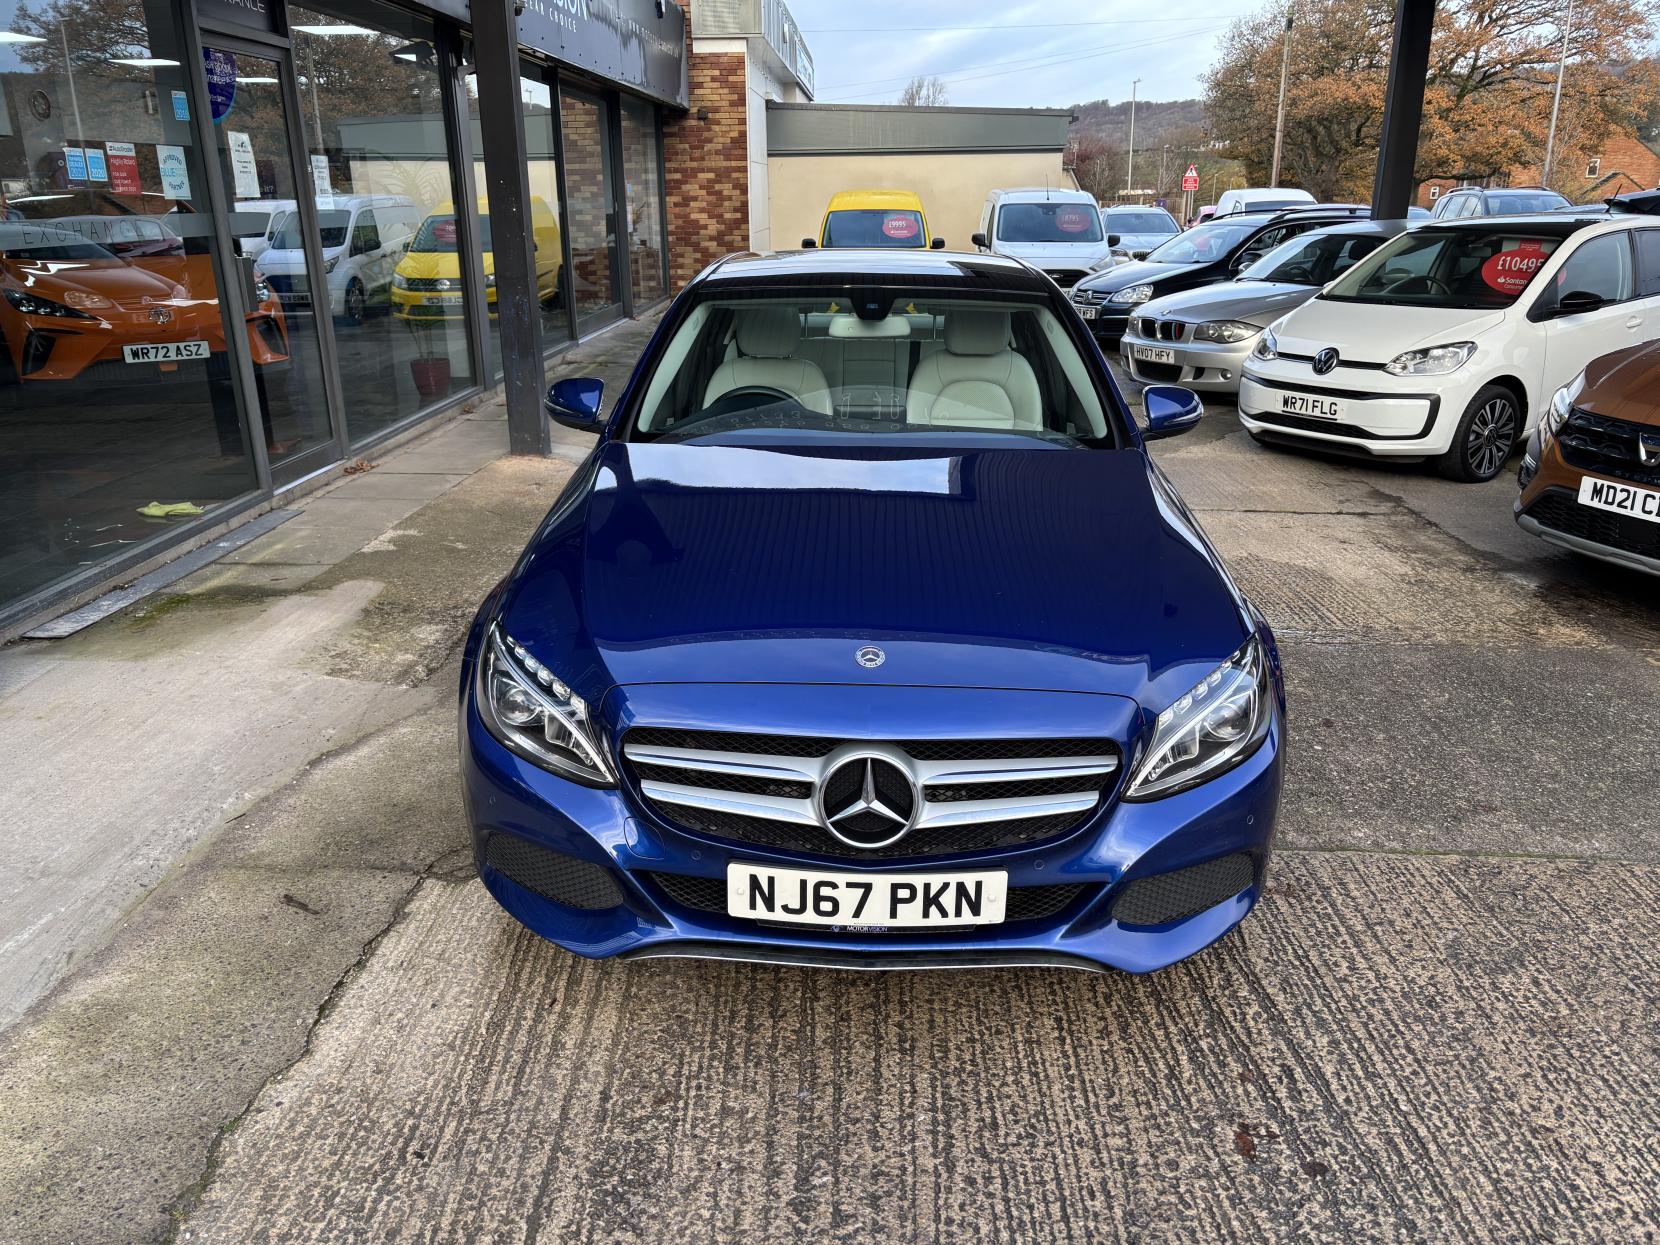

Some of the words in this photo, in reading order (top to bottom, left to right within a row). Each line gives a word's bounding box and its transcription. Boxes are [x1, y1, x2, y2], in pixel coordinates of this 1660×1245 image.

[549, 8, 577, 32] CHOICE
[1505, 277, 1528, 285] Santan
[130, 346, 171, 361] WR72
[175, 343, 204, 358] ASZ
[1136, 347, 1153, 358] HV07
[1154, 350, 1171, 362] HFY
[1283, 394, 1309, 412] WR71
[1312, 400, 1338, 416] FLG
[1590, 482, 1638, 511] MD21
[1641, 493, 1660, 518] C
[749, 873, 874, 919] NJ67
[889, 879, 983, 919] PKN
